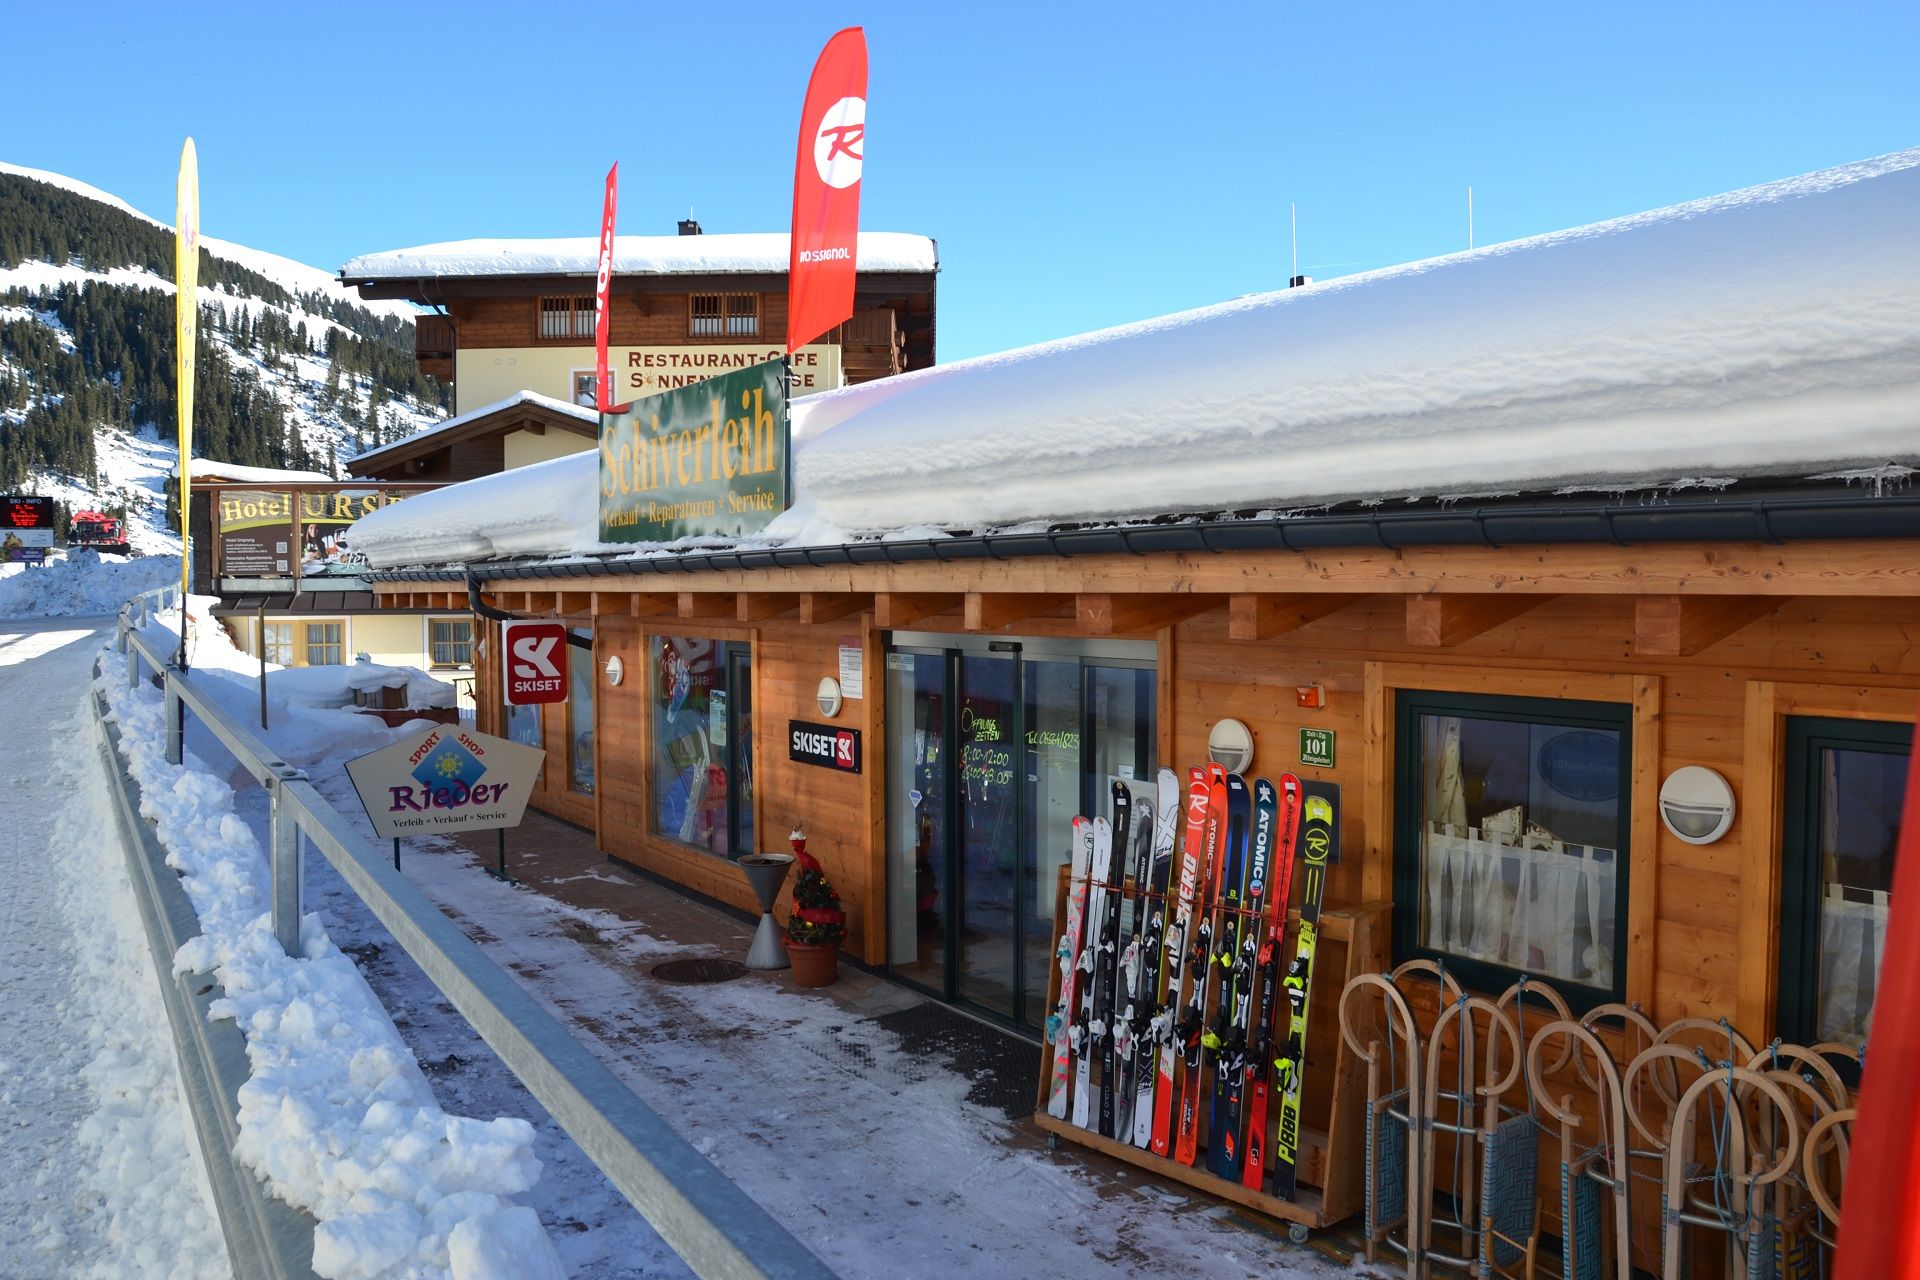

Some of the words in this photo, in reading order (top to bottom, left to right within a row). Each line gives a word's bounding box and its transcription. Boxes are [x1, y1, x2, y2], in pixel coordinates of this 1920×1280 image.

[800, 247, 850, 262] ROSSIGNOL
[603, 387, 776, 499] Schiverleih
[222, 494, 291, 521] Hotel
[604, 503, 641, 528] Verkauf
[648, 499, 715, 527] Reparaturen
[727, 487, 775, 513] Service
[514, 679, 562, 693] SKISET
[408, 731, 441, 766] SPORT
[458, 733, 485, 757] SHOP
[793, 731, 837, 757] SKISET
[1306, 738, 1327, 756] 101
[388, 778, 509, 813] Rieder
[393, 817, 424, 829] Verleih
[433, 813, 468, 824] Verkauf
[476, 811, 507, 821] Service
[1207, 818, 1217, 860] ATOMIC
[1252, 808, 1270, 880] ATOMIC
[1139, 856, 1147, 884] ATOMIC
